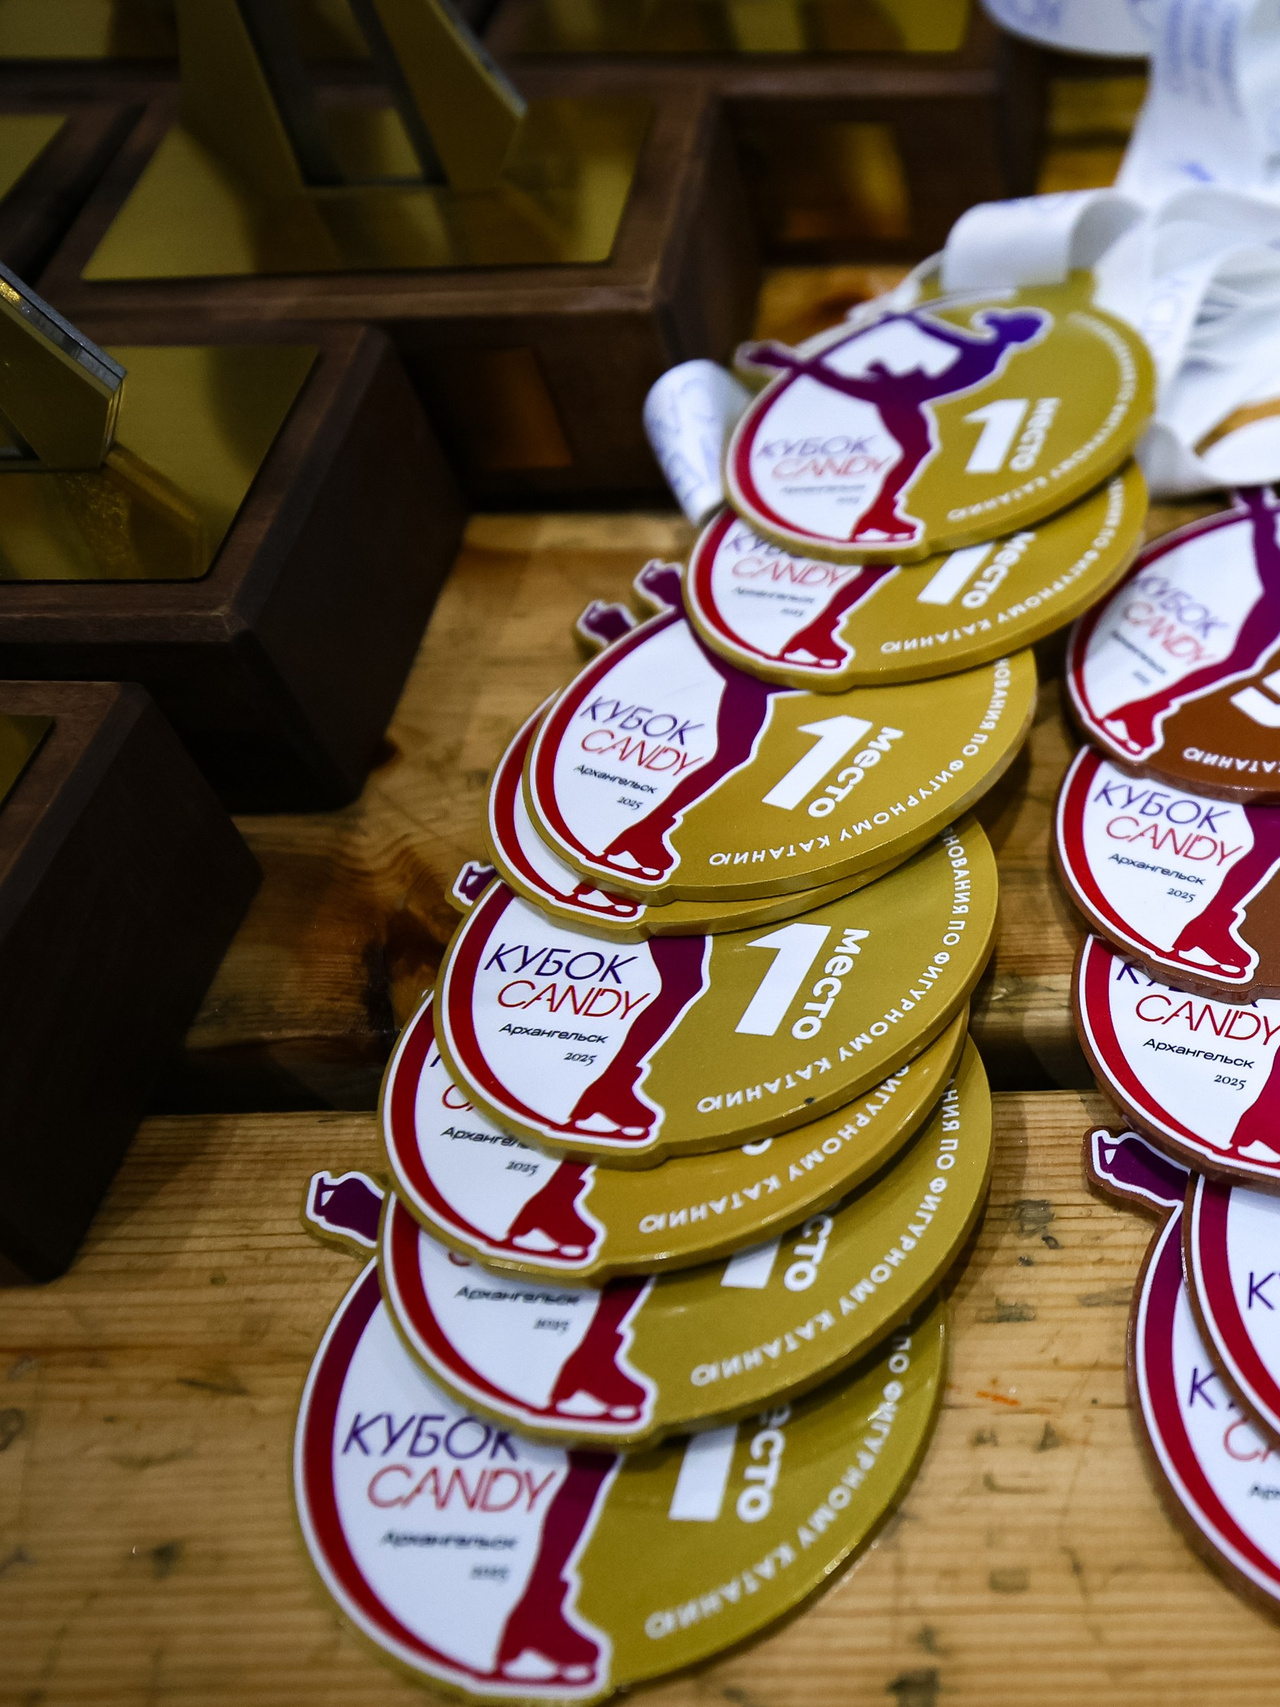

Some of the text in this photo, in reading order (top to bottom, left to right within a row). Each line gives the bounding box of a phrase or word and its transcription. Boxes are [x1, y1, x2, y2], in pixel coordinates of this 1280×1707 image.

[962, 398, 1029, 473] 1
[771, 456, 894, 480] CANDY
[732, 557, 854, 587] CANDY
[961, 532, 1036, 609] Место
[880, 620, 992, 653] КАТАНИЮ
[580, 696, 705, 746] КУБОК
[964, 732, 988, 758] ПО
[580, 730, 705, 777] CANDY
[762, 714, 874, 810] 1
[808, 726, 904, 818] Место
[574, 763, 658, 794] Архангельск
[839, 758, 965, 842] ФИГУРНОМУ
[617, 797, 643, 810] 2025
[1094, 780, 1232, 834] КУБОК
[709, 836, 831, 866] КАТАНИЮ
[1106, 815, 1246, 868] CANDY
[1107, 851, 1206, 886] Архангельск
[1167, 887, 1196, 904] 2025
[942, 919, 966, 946] ПО
[485, 943, 638, 985] КУБОК
[734, 922, 831, 1036] 1
[791, 928, 870, 1041] Место
[498, 980, 650, 1021] CANDY
[837, 951, 952, 1061] ФИГУРНОМУ
[498, 1022, 608, 1046] Архангельск
[564, 1051, 598, 1065] 2025
[1143, 1037, 1255, 1070] Архангельск
[696, 1058, 832, 1114] КАТАНИЮ
[1214, 1073, 1247, 1091] 2025
[505, 1159, 539, 1176] 2025
[936, 1136, 958, 1170] ПО
[638, 1176, 779, 1234] КАТАНИЮ
[784, 1215, 834, 1291] сто
[840, 1177, 946, 1316] ФИГУРНОМУ
[691, 1309, 834, 1386] КАТАНИЮ
[342, 1412, 521, 1460] КУБОК
[737, 1407, 790, 1523] есто
[797, 1379, 904, 1549] ФИГУРНОМУ
[367, 1464, 556, 1513] CANDY
[645, 1543, 797, 1640] КАТАНИЮ
